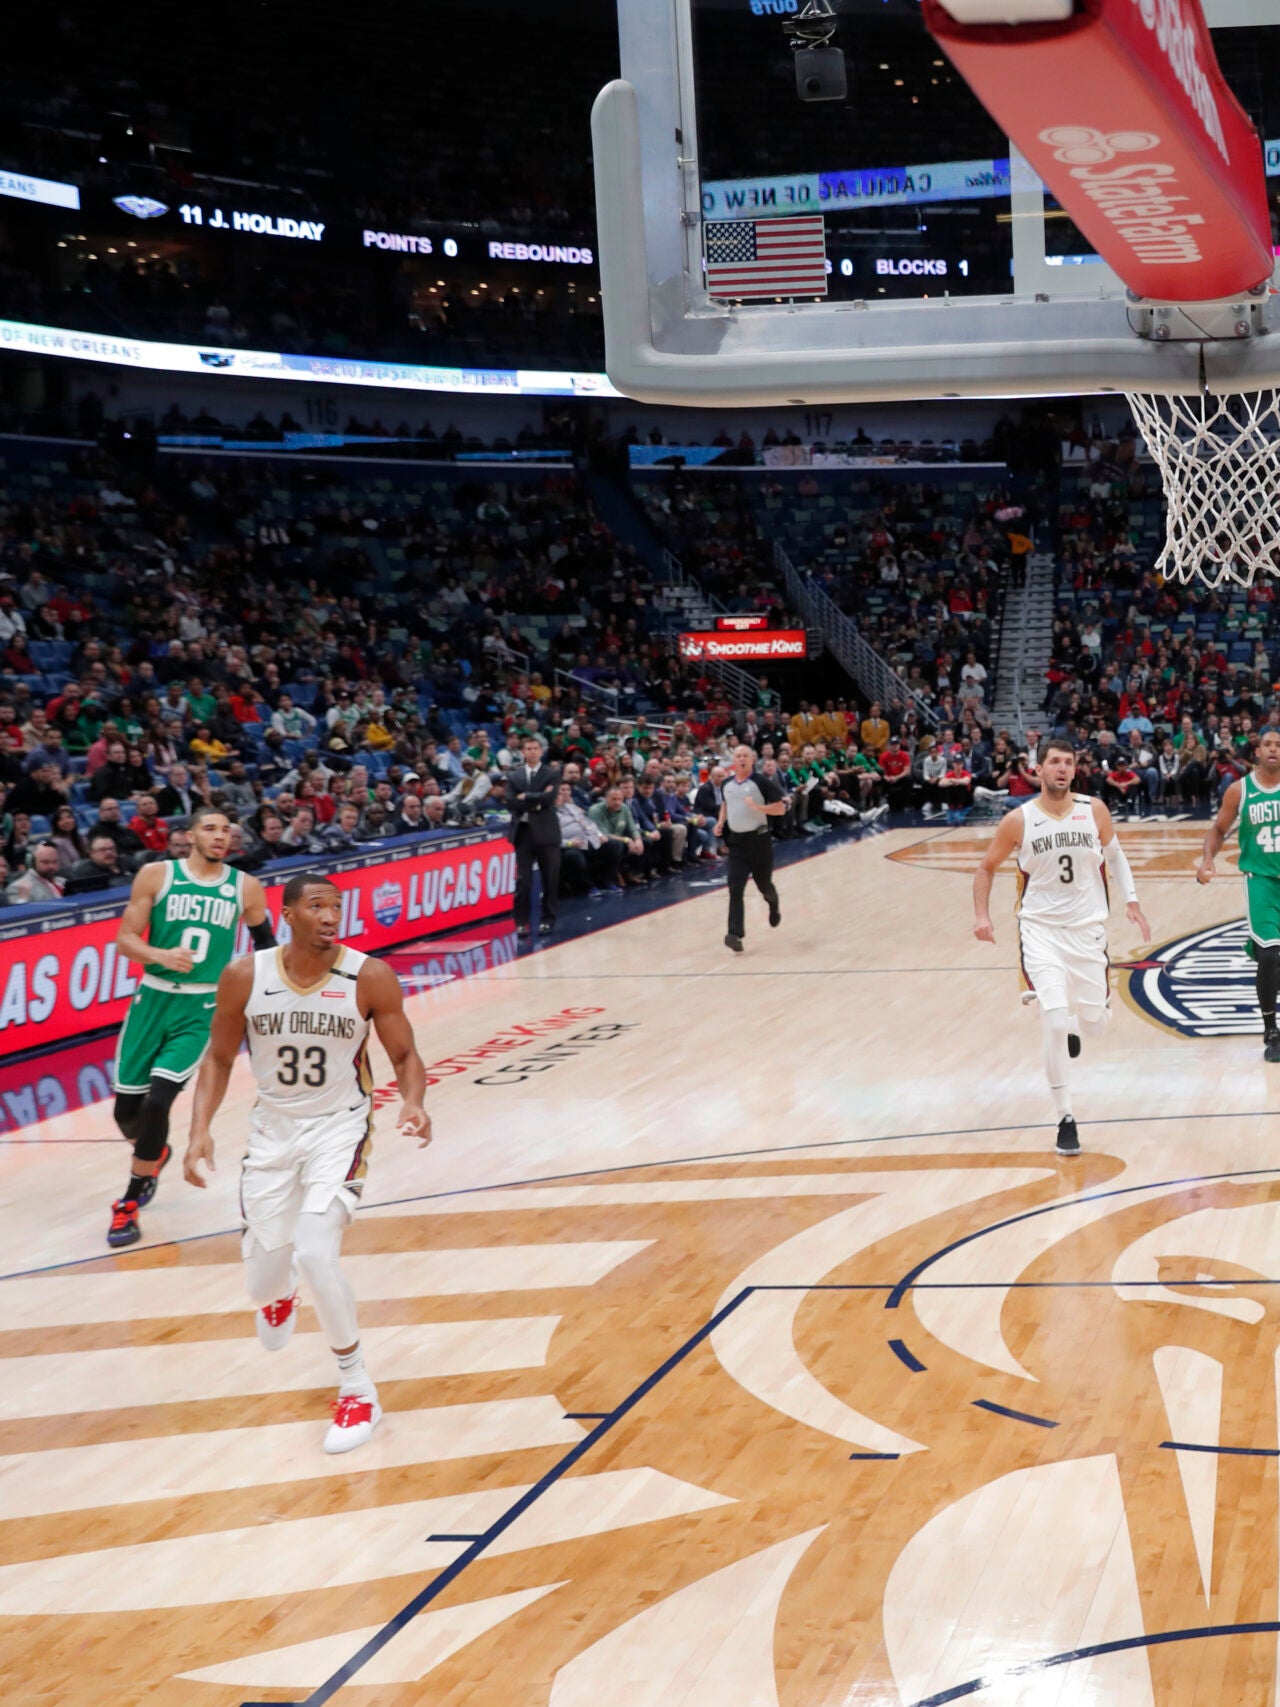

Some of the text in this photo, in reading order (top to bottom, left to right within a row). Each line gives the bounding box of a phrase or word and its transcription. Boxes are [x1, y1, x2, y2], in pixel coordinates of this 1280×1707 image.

[179, 204, 325, 241] 11 J. HOLIDAY
[363, 230, 458, 257] POINTS 0
[489, 241, 593, 264] REBOUNDS
[841, 260, 853, 276] 0
[876, 259, 968, 276] BLOCKS 1
[71, 337, 142, 360] ORLEANS
[805, 413, 833, 437] 117
[706, 641, 770, 656] SMOOTHIE
[1031, 831, 1094, 856] NEW ORLEANS
[1058, 854, 1074, 884] 3
[407, 859, 483, 921] LUCAS
[486, 852, 517, 900] OIL
[165, 893, 237, 930] BOSTON
[180, 926, 211, 963] 0
[69, 942, 139, 1011] OIL
[252, 1010, 356, 1040] NEW ORLEANS
[277, 1045, 327, 1088] 33
[473, 1023, 642, 1086] CENTER
